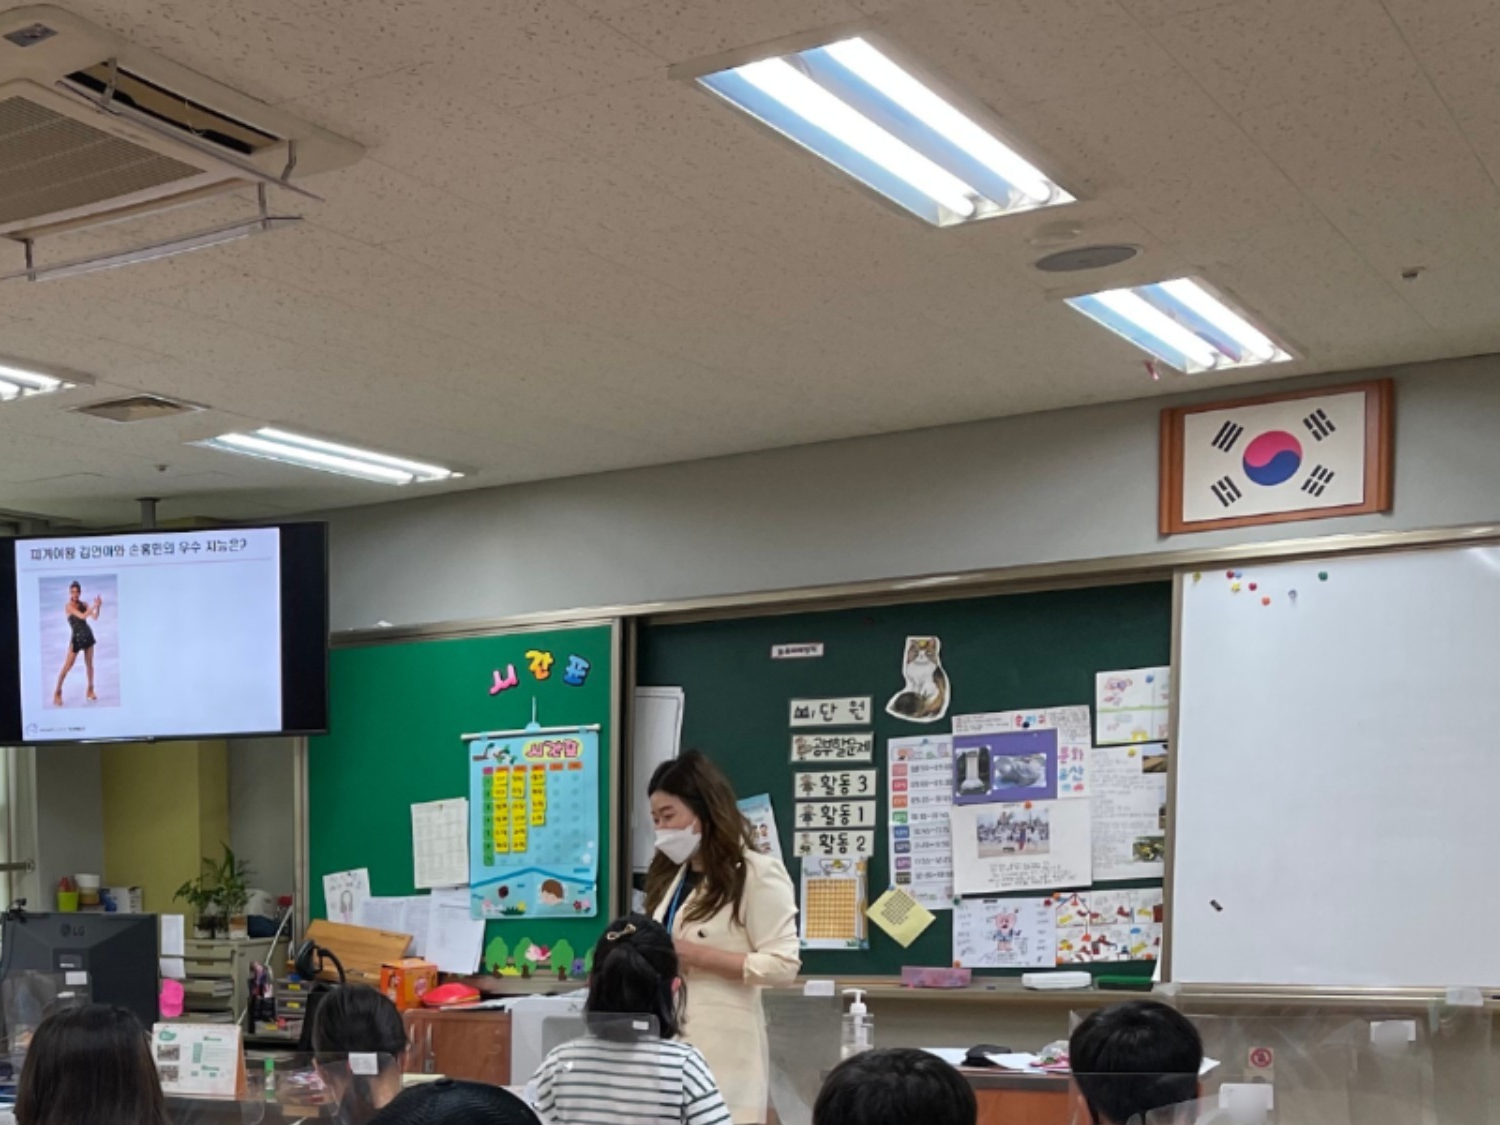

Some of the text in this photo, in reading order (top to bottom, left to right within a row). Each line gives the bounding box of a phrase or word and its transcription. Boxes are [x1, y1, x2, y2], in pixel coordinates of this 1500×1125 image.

[489, 649, 591, 696] 시간표
[820, 773, 868, 796] 활동 3
[820, 803, 864, 826] 활동 1
[818, 832, 866, 855] 활동 2
[72, 926, 85, 937] LG
